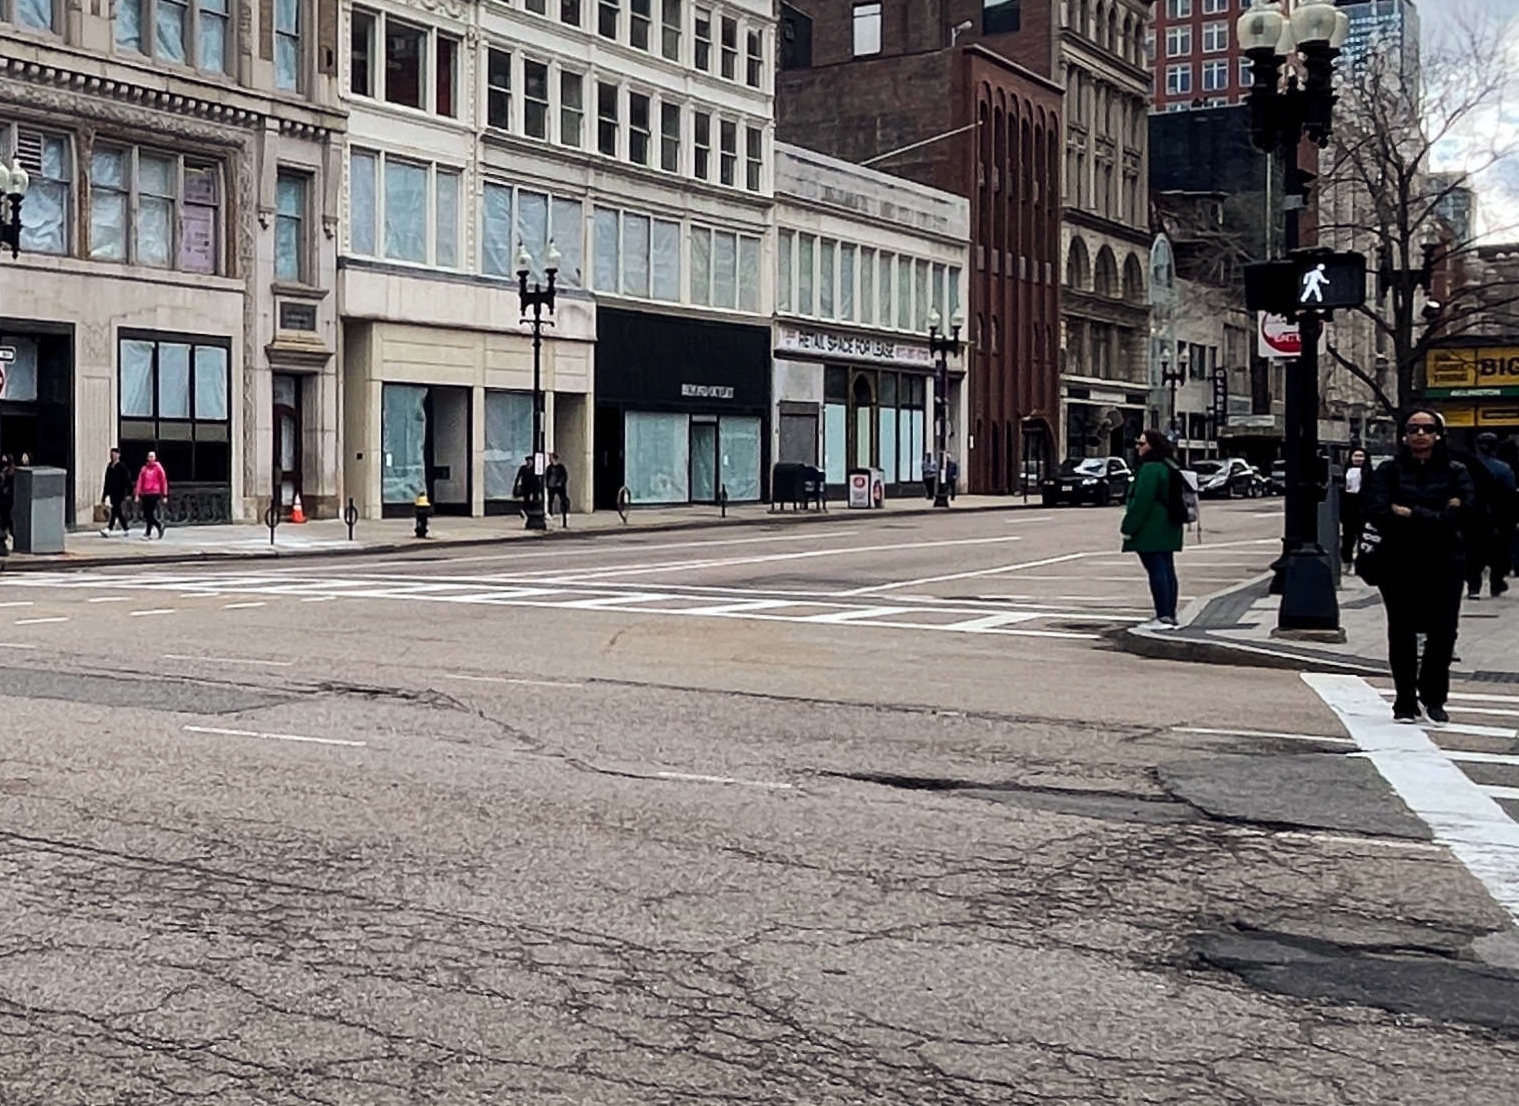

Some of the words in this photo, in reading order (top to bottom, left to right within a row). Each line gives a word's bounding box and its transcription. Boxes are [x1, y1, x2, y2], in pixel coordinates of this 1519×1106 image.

[799, 332, 825, 350] RETAIL
[827, 334, 853, 354] SPACE
[855, 337, 871, 355] FOR
[872, 340, 894, 359] LEASE
